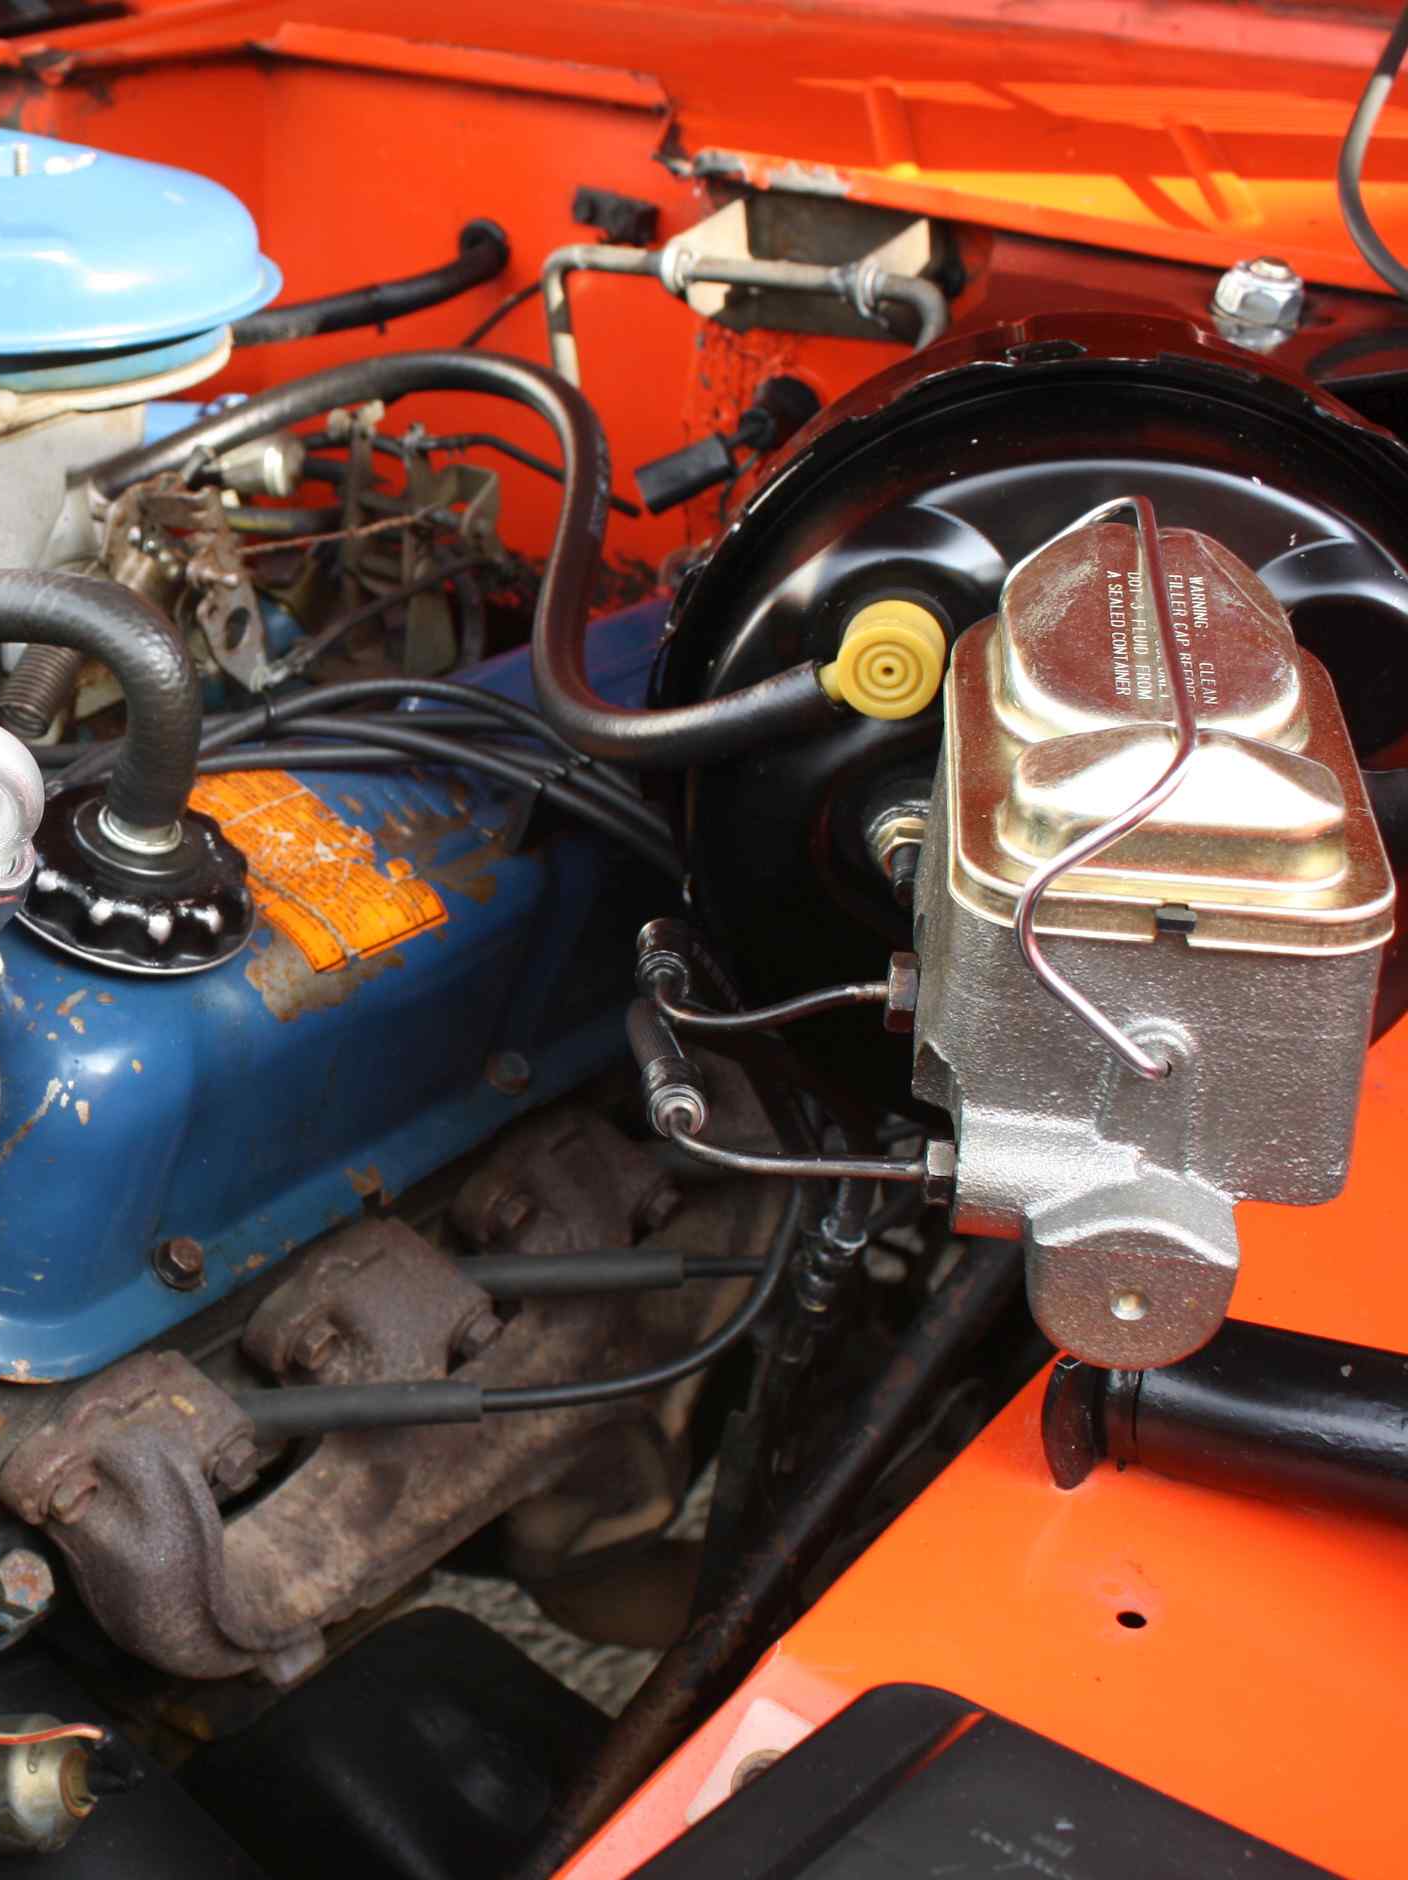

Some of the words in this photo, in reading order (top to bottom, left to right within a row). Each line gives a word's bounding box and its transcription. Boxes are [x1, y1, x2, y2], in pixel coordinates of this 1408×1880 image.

[1106, 570, 1122, 579] A
[1108, 583, 1126, 628] SEALED
[1168, 574, 1189, 617] FILLER
[1131, 619, 1149, 655] FLUID
[1173, 622, 1190, 647] CAP
[1111, 632, 1132, 696] CONTAINER
[1135, 665, 1153, 700] FROM
[1199, 662, 1218, 705] CLEAN
